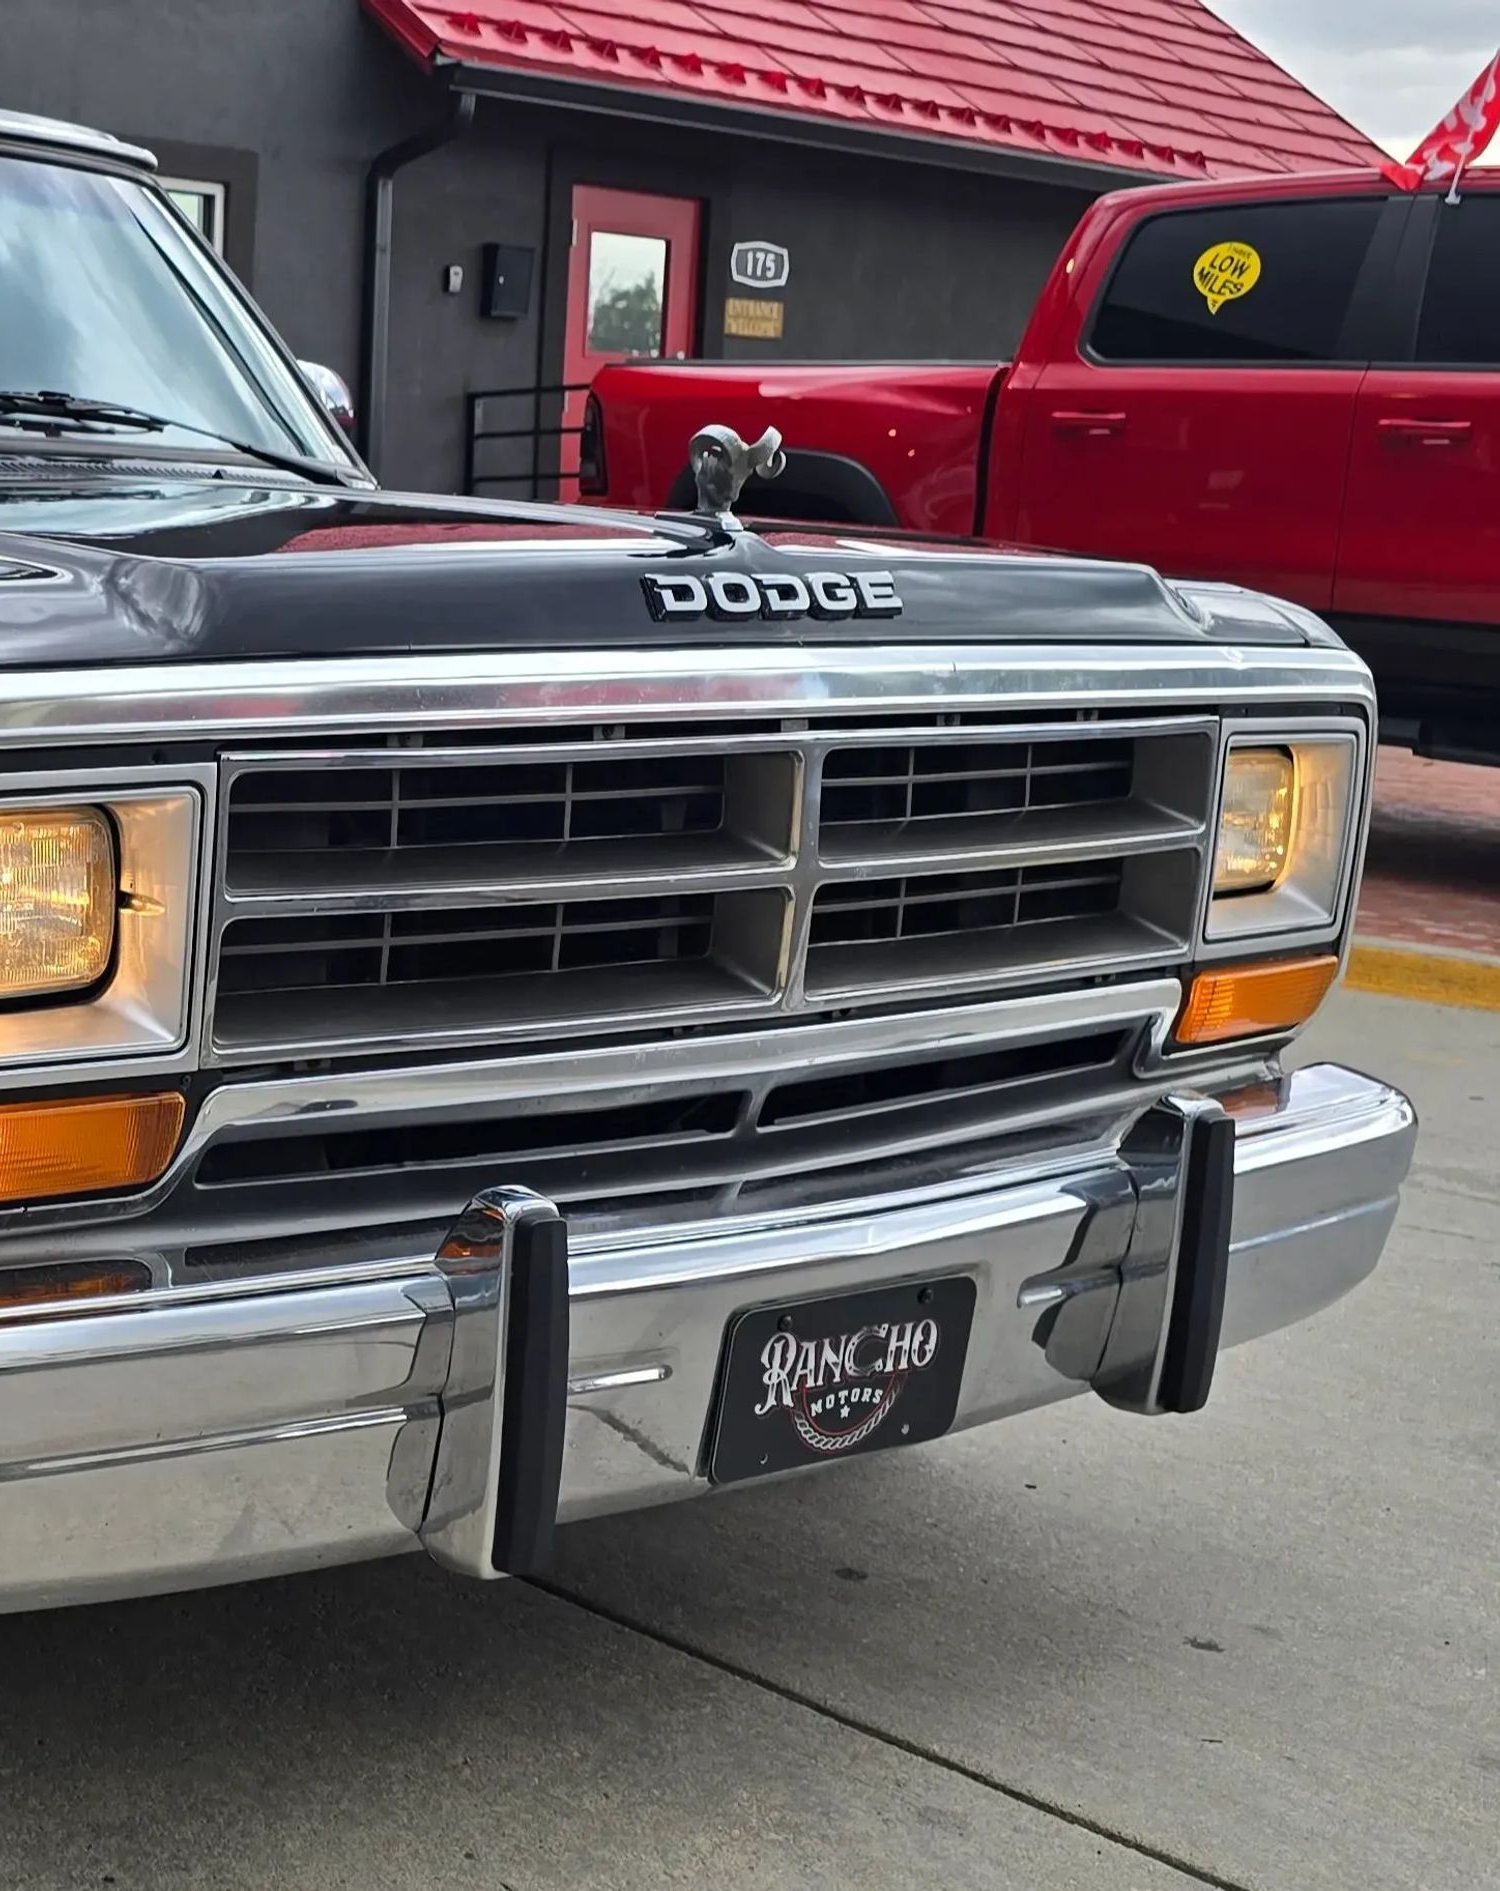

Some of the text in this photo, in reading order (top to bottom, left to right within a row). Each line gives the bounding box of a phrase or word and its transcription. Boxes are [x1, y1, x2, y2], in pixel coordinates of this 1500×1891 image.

[746, 251, 776, 278] 175
[1209, 252, 1251, 280] LOW
[1197, 266, 1244, 296] MILES
[641, 571, 904, 620] DODGE
[754, 1318, 938, 1416] RANCHO
[810, 1387, 884, 1418] MOTORS
